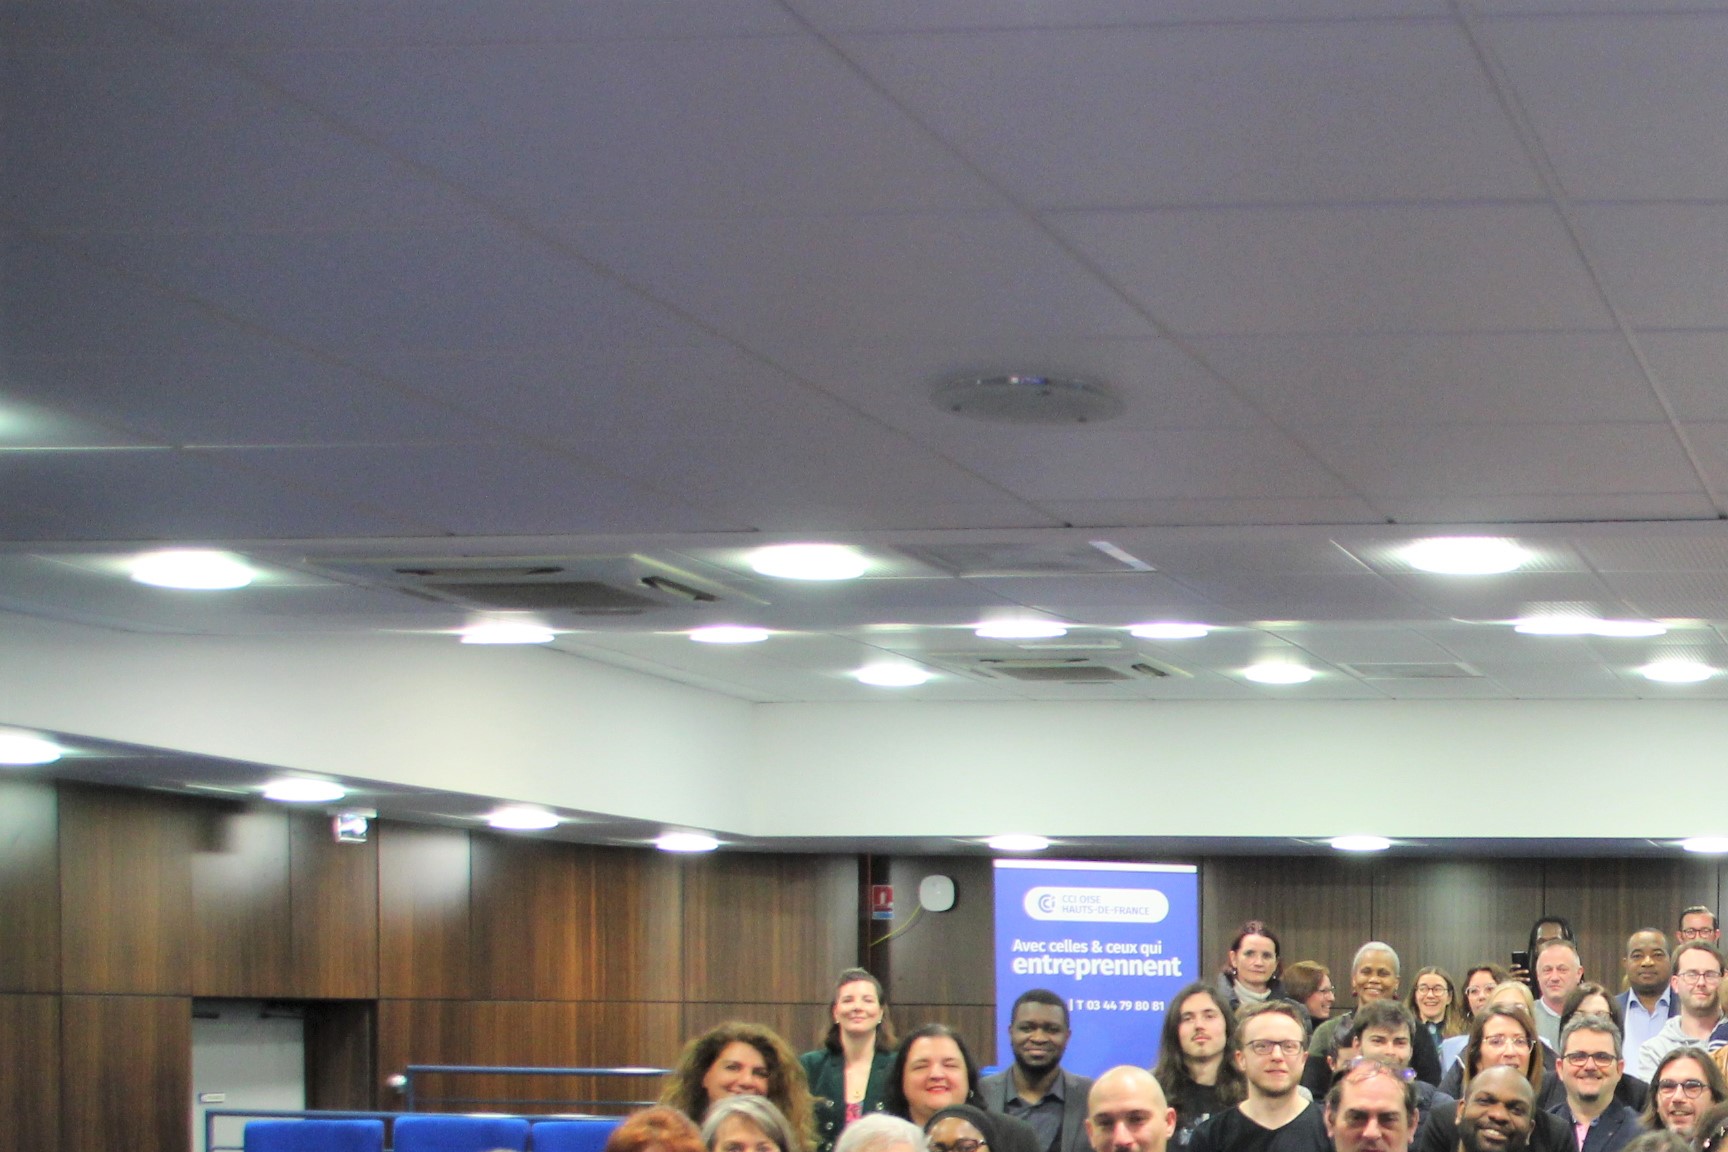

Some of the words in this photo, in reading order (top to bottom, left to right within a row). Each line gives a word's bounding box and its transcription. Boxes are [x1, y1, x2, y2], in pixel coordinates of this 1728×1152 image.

[1062, 895, 1076, 904] CCI
[1079, 895, 1101, 904] OISE
[1062, 906, 1149, 915] HAUTS-DE-FRANCE
[1013, 939, 1046, 952] Avec
[1048, 939, 1088, 954] celles
[1091, 940, 1103, 954] &
[1107, 943, 1137, 954] ceux
[1141, 941, 1162, 957] qui
[1013, 955, 1182, 980] entreprennent
[1077, 1000, 1084, 1011] T
[1086, 1000, 1101, 1012] 03
[1103, 1000, 1118, 1012] 44
[1120, 1001, 1132, 1012] 79
[1135, 1001, 1150, 1012] 80
[1152, 1001, 1165, 1012] 81
